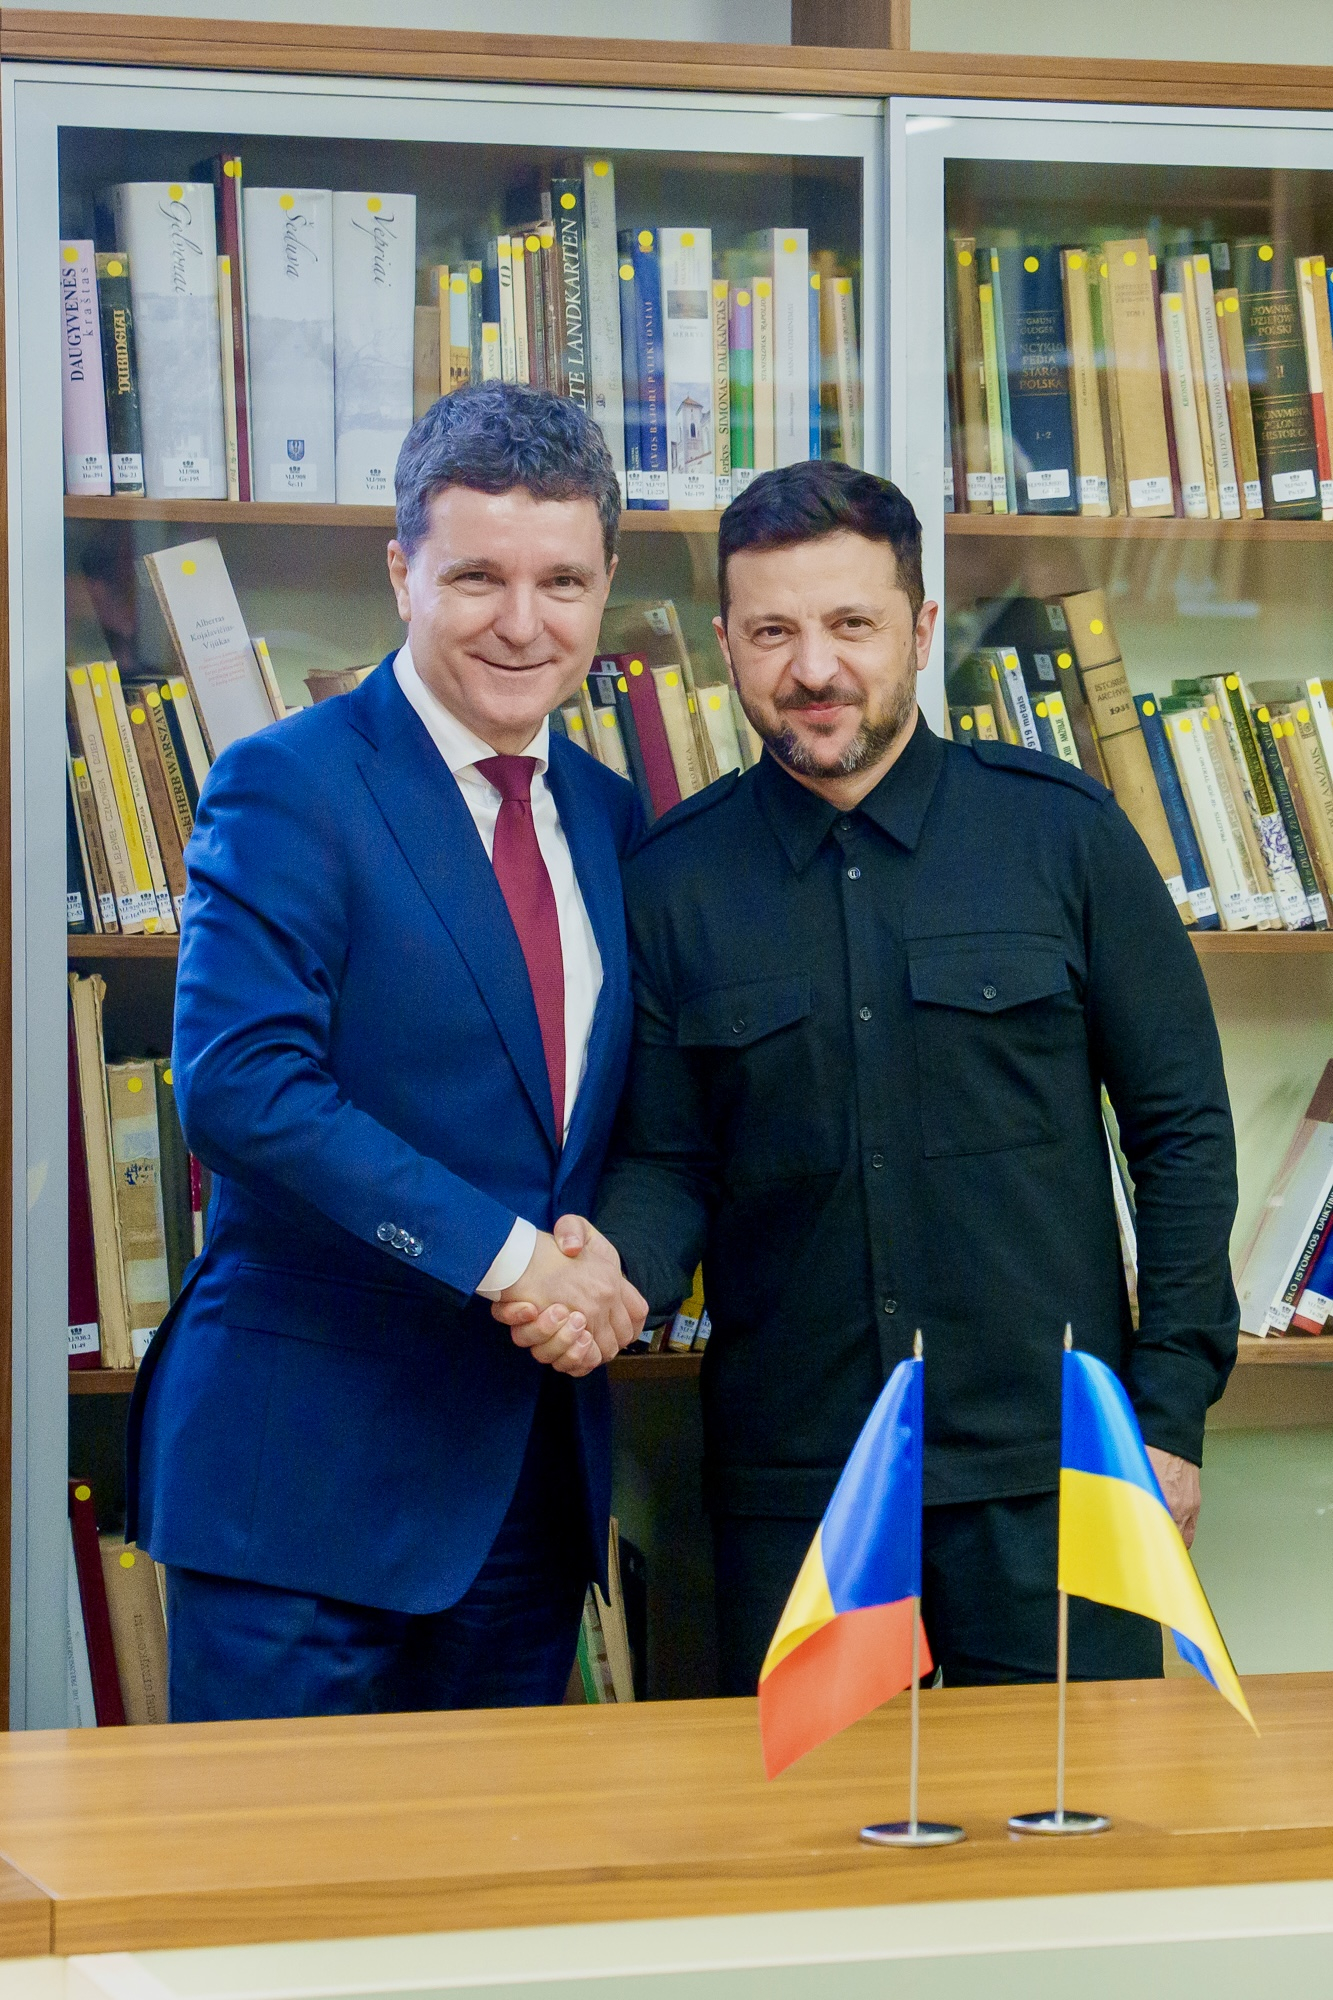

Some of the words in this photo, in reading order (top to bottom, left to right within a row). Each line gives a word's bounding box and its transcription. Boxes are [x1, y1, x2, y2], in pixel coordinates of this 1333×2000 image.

[352, 212, 396, 288] Vepriai
[81, 266, 95, 337] kraštas
[561, 217, 585, 366] LANDKARTEN
[60, 266, 85, 382] DAUGYVENĖS
[716, 301, 728, 372] DAUKANTAS
[1172, 314, 1185, 370] WIELKOPOLSKA
[1204, 306, 1216, 360] ZACHODEM
[1019, 379, 1063, 390] POLSKA
[1022, 355, 1056, 365] PEDIA
[1023, 367, 1059, 377] STARO
[568, 371, 587, 411] LTE
[717, 378, 729, 434] SIMONAS
[1179, 374, 1190, 407] KRONIKA
[1212, 373, 1225, 428] WSCHODEM
[649, 434, 659, 471] UVOS
[195, 615, 225, 629] Albertas
[1016, 695, 1029, 727] metais
[152, 704, 178, 775] WARSZAW
[172, 774, 189, 814] HERB
[686, 747, 699, 790] STORICA
[1311, 746, 1330, 798] AMŽIAIS
[1285, 1283, 1298, 1304] SLO
[1294, 1233, 1321, 1282] ISTORIJOS
[145, 1693, 159, 1724] ACIEJ
